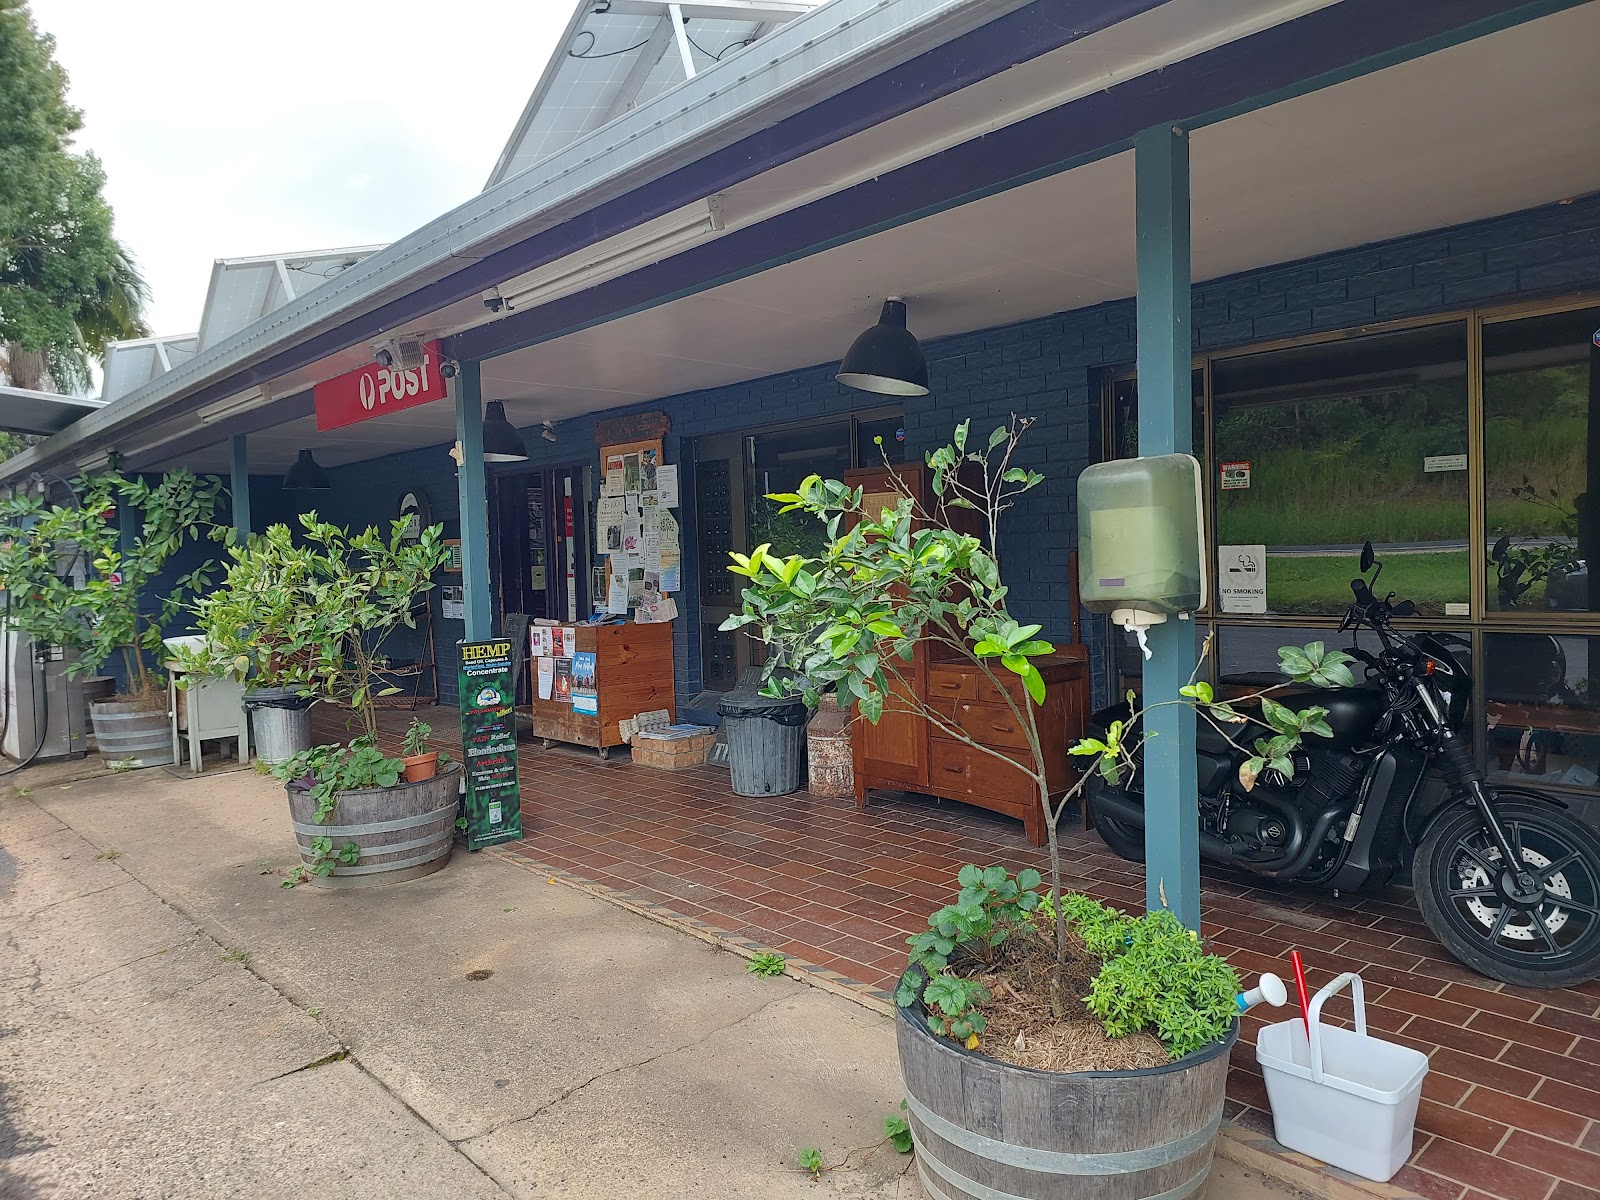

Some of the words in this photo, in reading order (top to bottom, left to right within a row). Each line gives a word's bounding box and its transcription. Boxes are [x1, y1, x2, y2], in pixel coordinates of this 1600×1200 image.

[377, 354, 429, 404] POST
[1221, 463, 1249, 471] WARNING
[461, 643, 511, 661] HEMP
[466, 667, 508, 677] Concentrate
[472, 735, 490, 743] PAIN
[467, 742, 516, 757] Headaches
